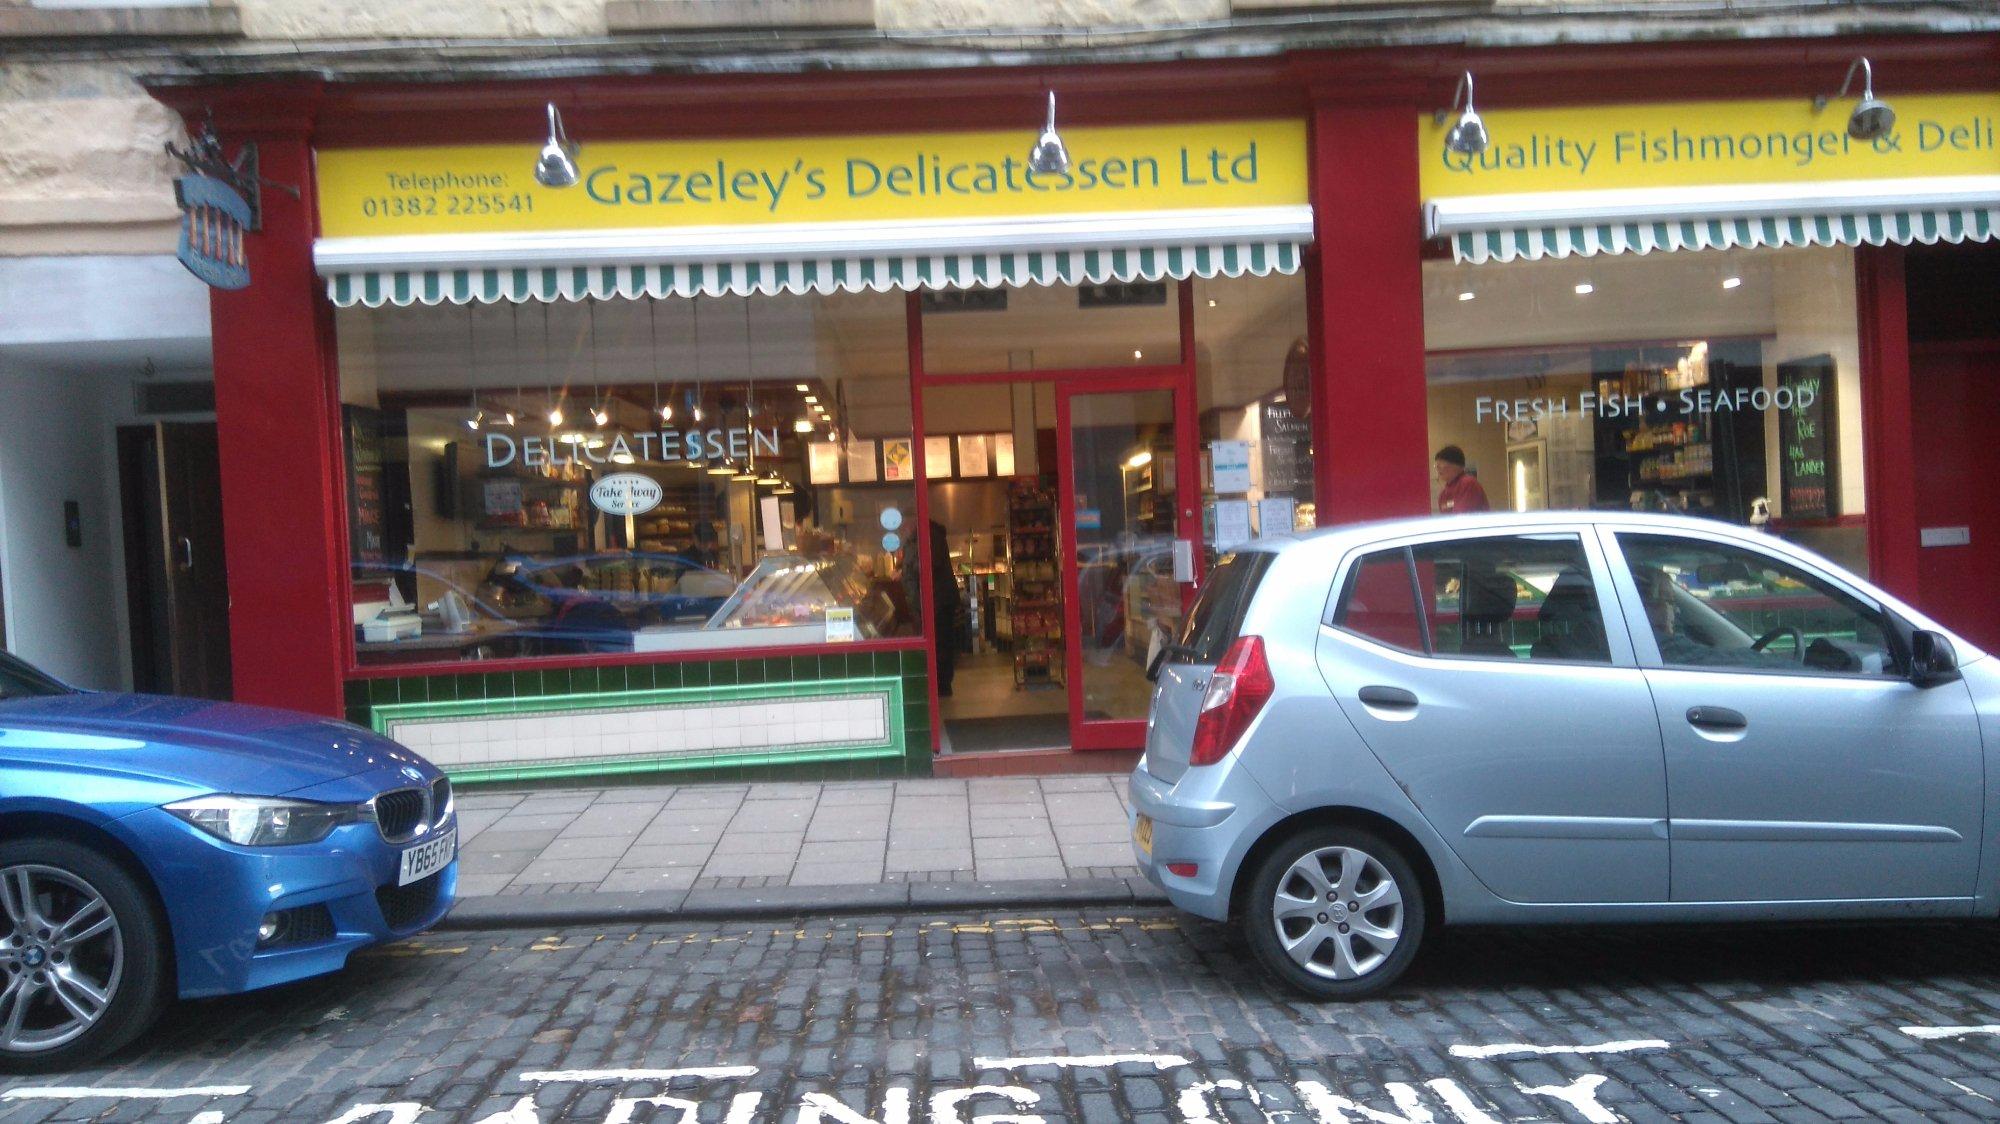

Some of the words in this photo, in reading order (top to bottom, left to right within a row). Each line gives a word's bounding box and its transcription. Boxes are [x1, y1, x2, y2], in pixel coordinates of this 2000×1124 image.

[1442, 133, 1597, 176] Quality
[1614, 128, 1850, 168] Fishmonger
[1872, 132, 1903, 154] &
[387, 172, 509, 193] Telephone:
[586, 157, 827, 213] Gazeley's
[847, 152, 1159, 197] Delicatessen
[1182, 139, 1258, 185] Ltd
[363, 195, 437, 217] 01382
[448, 192, 533, 216] 225541
[1475, 395, 1567, 424] FRESH
[1579, 389, 1644, 420] FISH
[1679, 384, 1815, 414] SEAFOOD
[485, 427, 780, 468] DELICATESSEN
[597, 486, 623, 498] Take
[408, 842, 439, 877] YB65
